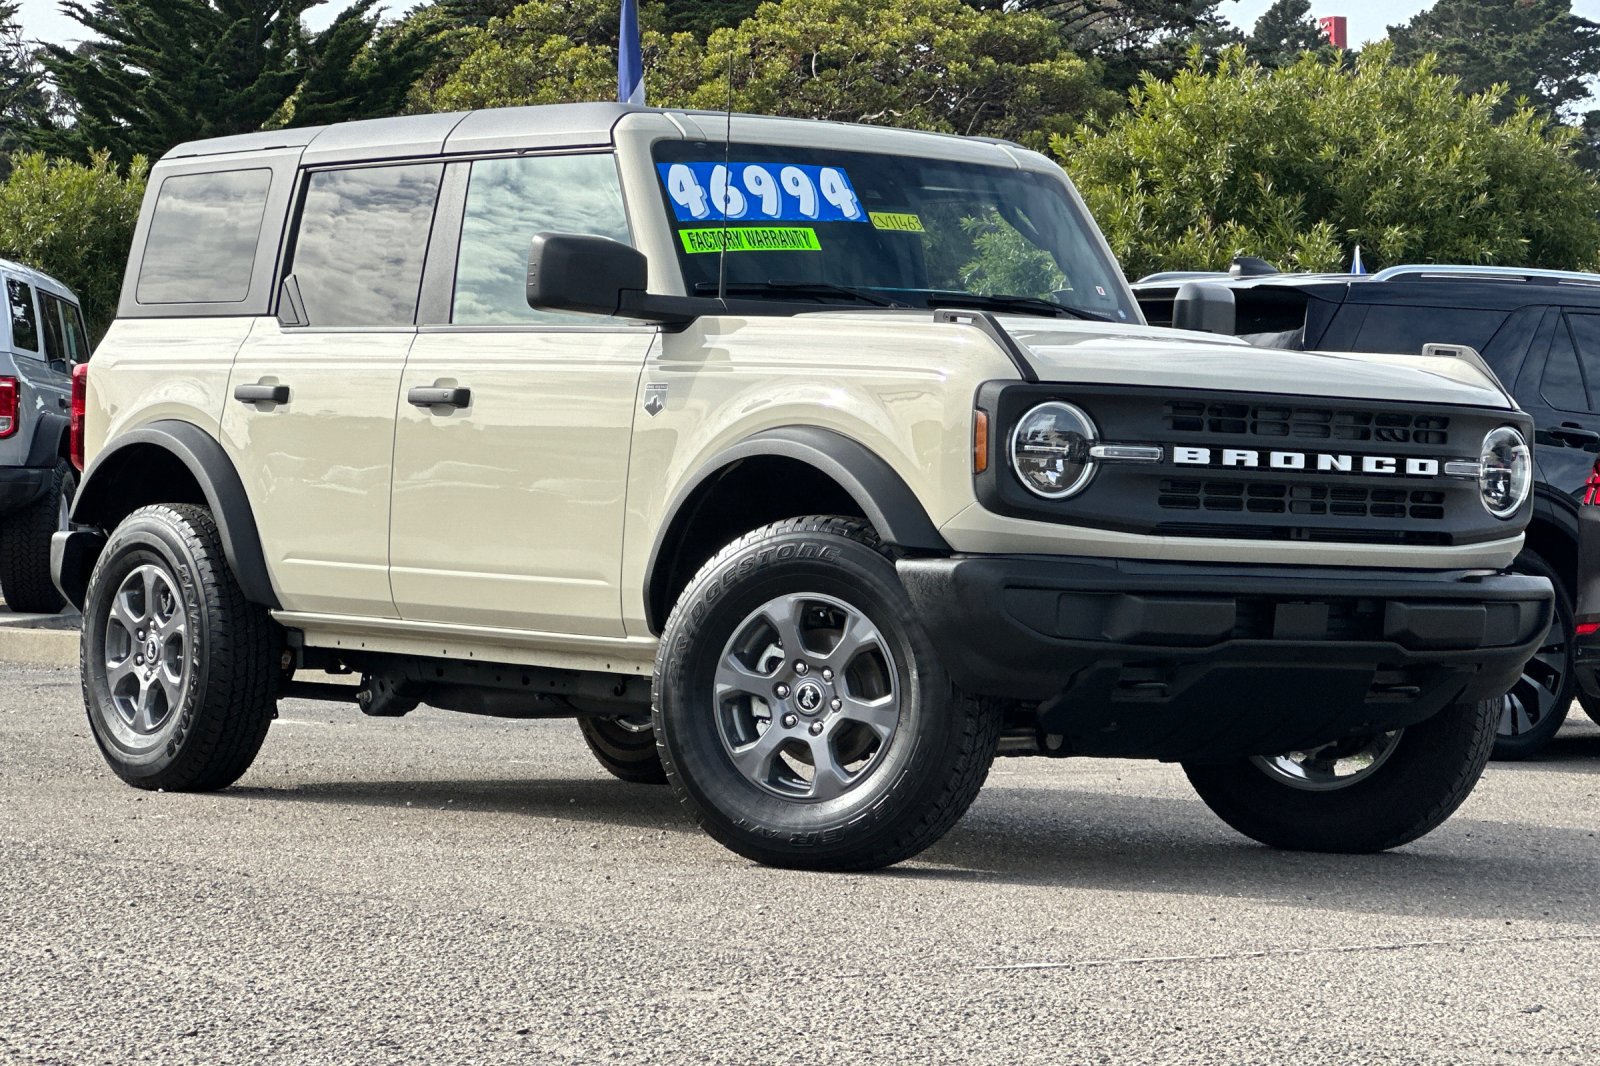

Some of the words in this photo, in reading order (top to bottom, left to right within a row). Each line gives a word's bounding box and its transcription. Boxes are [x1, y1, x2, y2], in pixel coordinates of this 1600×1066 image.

[667, 164, 860, 219] 46994
[687, 230, 743, 251] FACTORY
[744, 229, 811, 249] WARRANTY
[1173, 446, 1438, 475] BRONCO
[669, 542, 841, 688] BRIDGESTONE
